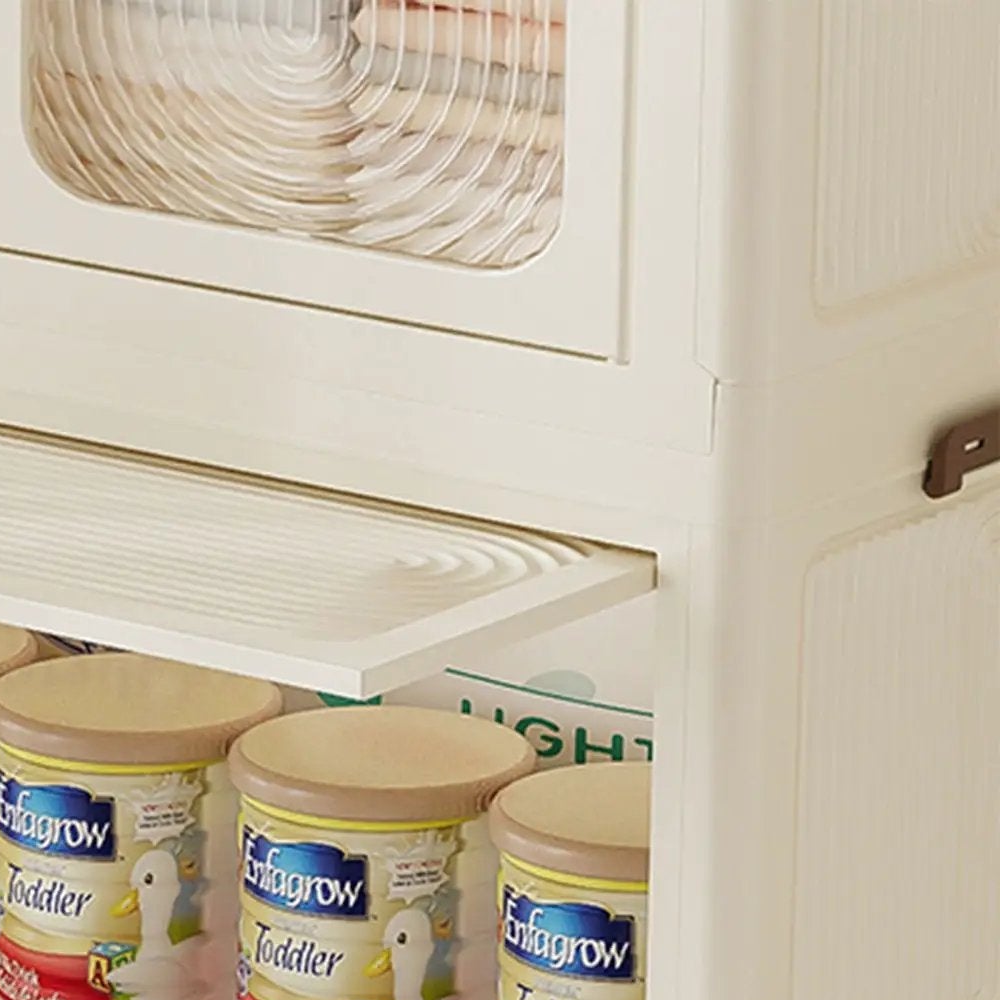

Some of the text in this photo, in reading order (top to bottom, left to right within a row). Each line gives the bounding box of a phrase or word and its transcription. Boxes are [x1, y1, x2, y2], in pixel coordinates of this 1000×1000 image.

[7, 863, 92, 916] Toddler
[244, 840, 363, 908] Enfagrow
[255, 921, 344, 977] Toddler
[505, 899, 630, 969] Enfagrow
